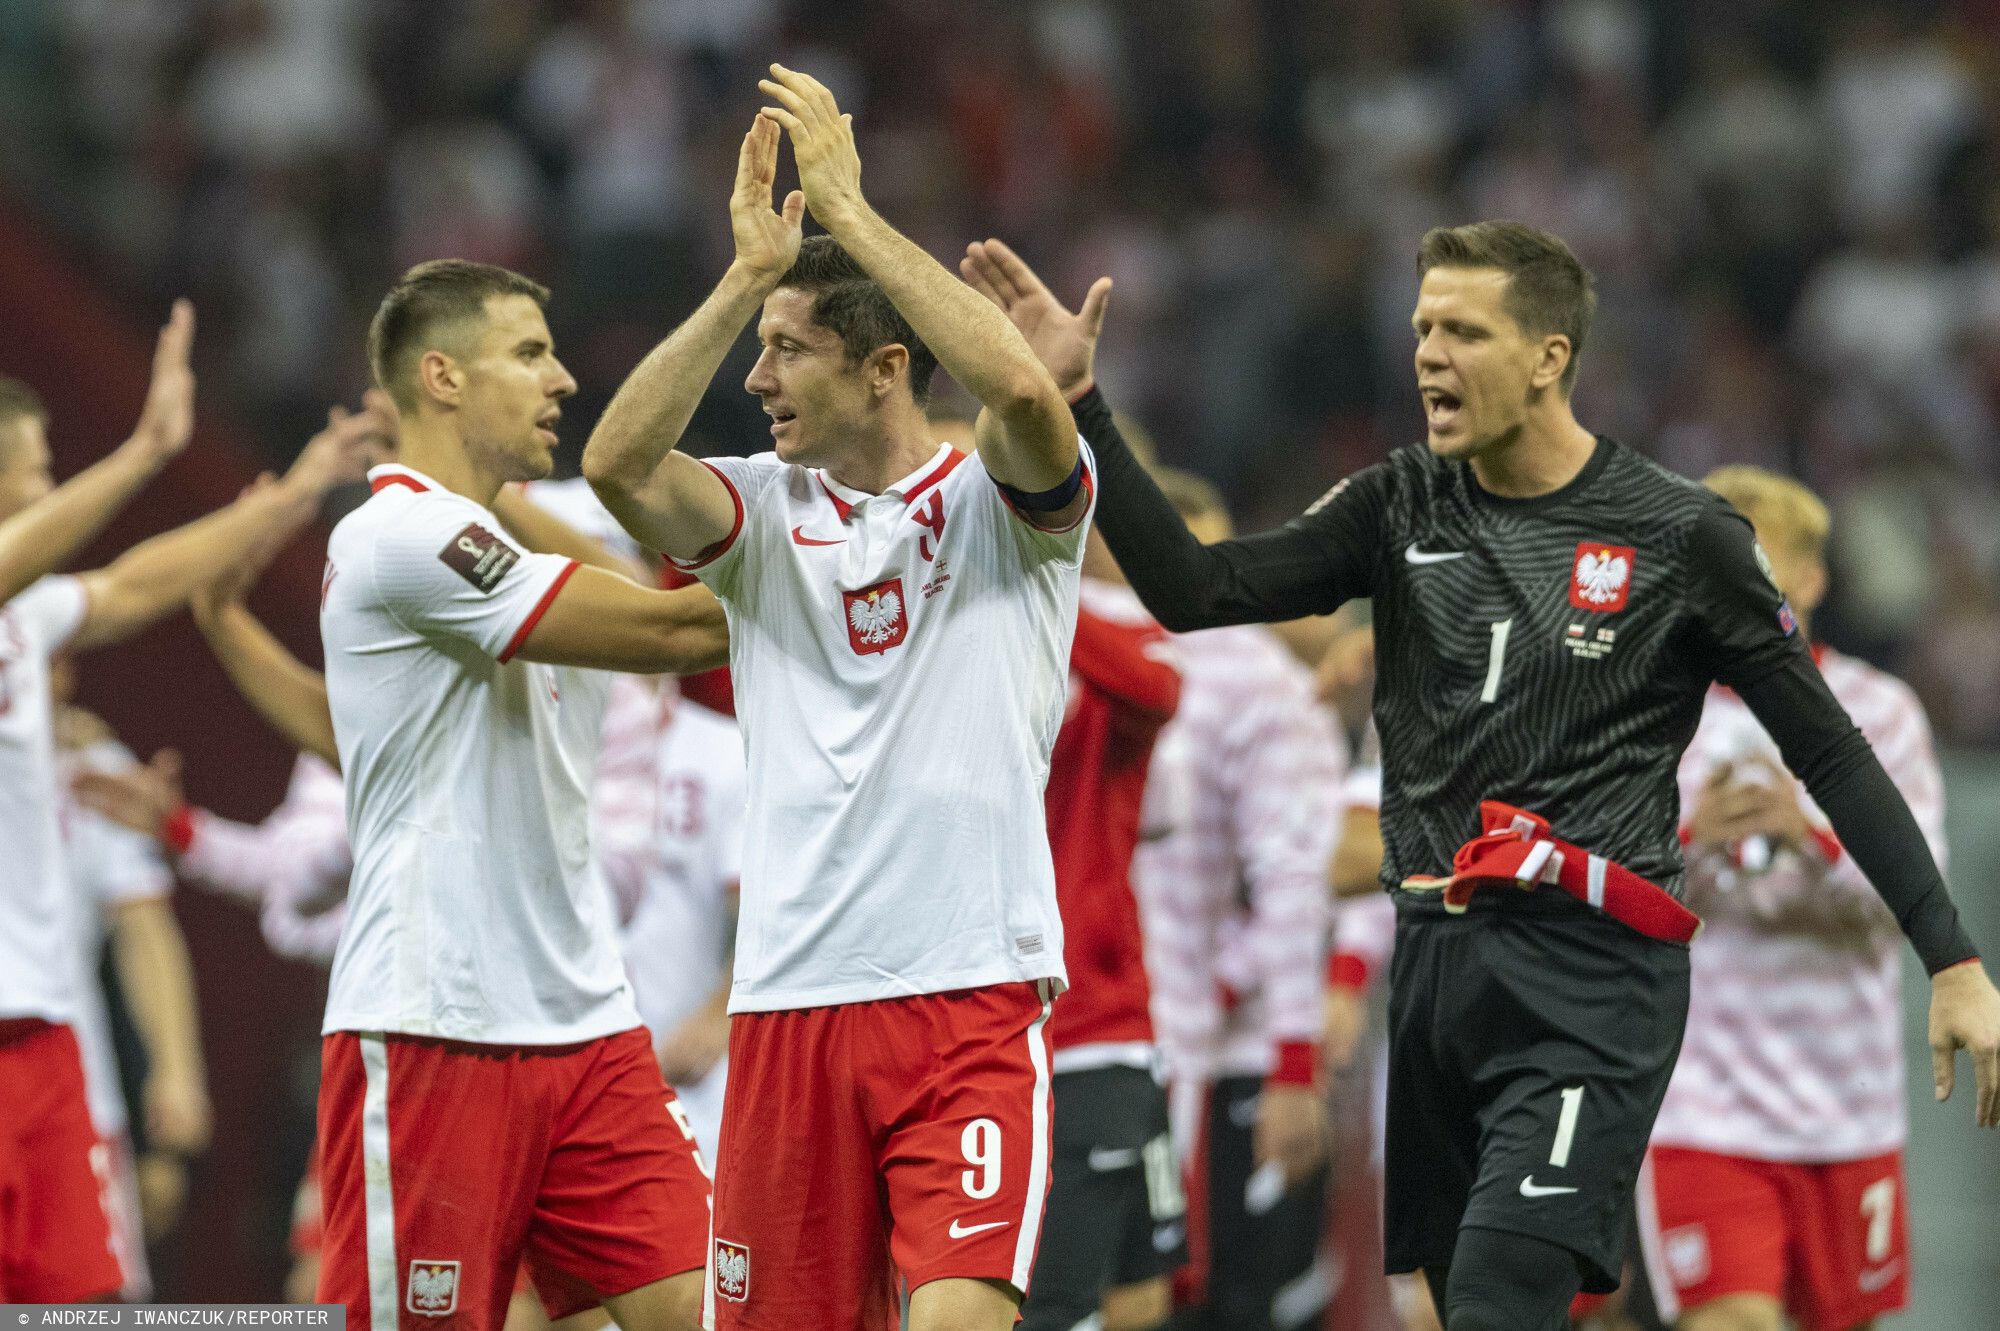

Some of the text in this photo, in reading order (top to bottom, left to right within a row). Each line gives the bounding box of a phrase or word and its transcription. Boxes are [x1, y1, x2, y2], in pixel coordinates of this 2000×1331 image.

[1480, 617, 1513, 703] 1
[960, 1118, 1002, 1200] 9
[1548, 1086, 1584, 1168] 1
[1860, 1177, 1896, 1261] 1
